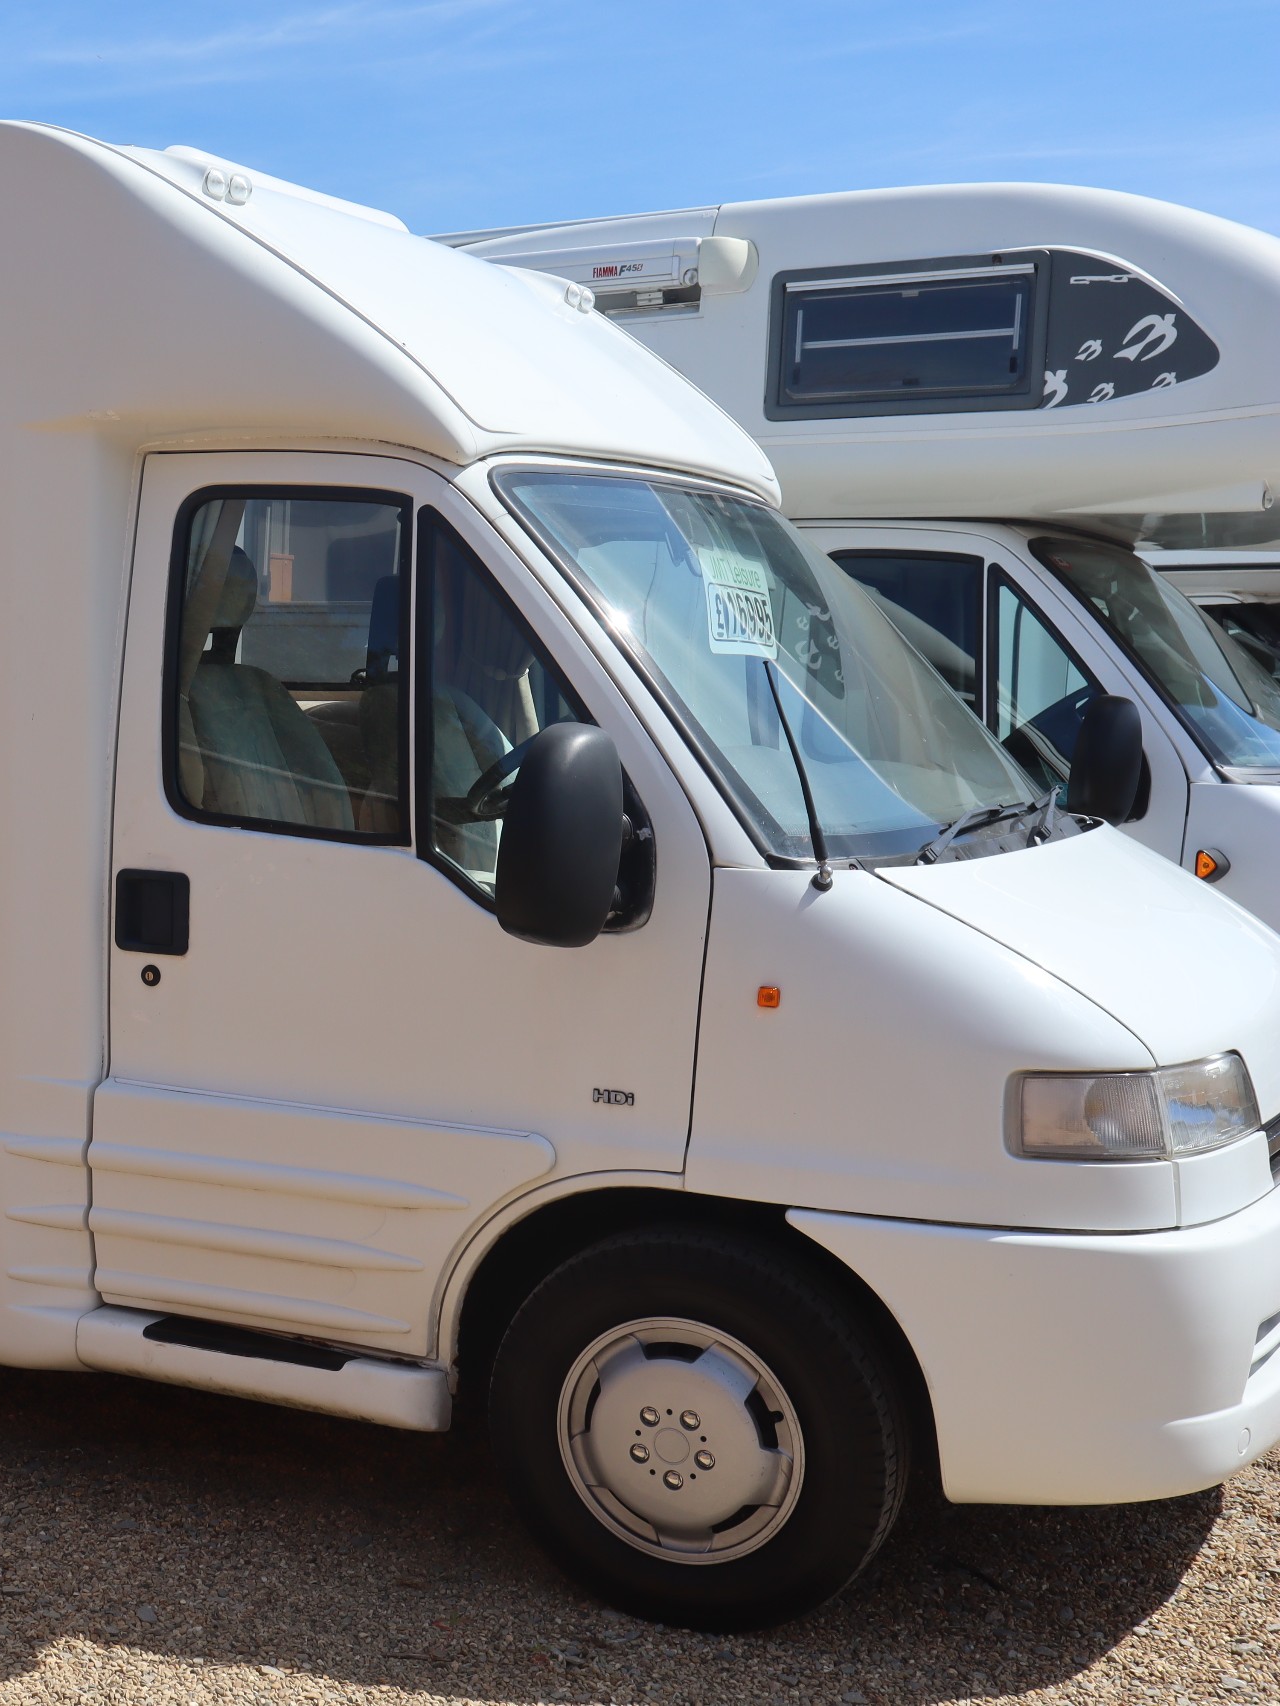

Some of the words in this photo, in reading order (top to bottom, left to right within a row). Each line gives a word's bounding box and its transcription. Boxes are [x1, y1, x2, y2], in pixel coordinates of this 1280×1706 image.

[592, 265, 618, 278] FIAMMA
[727, 559, 761, 588] Leisure
[592, 1087, 635, 1106] HDi
